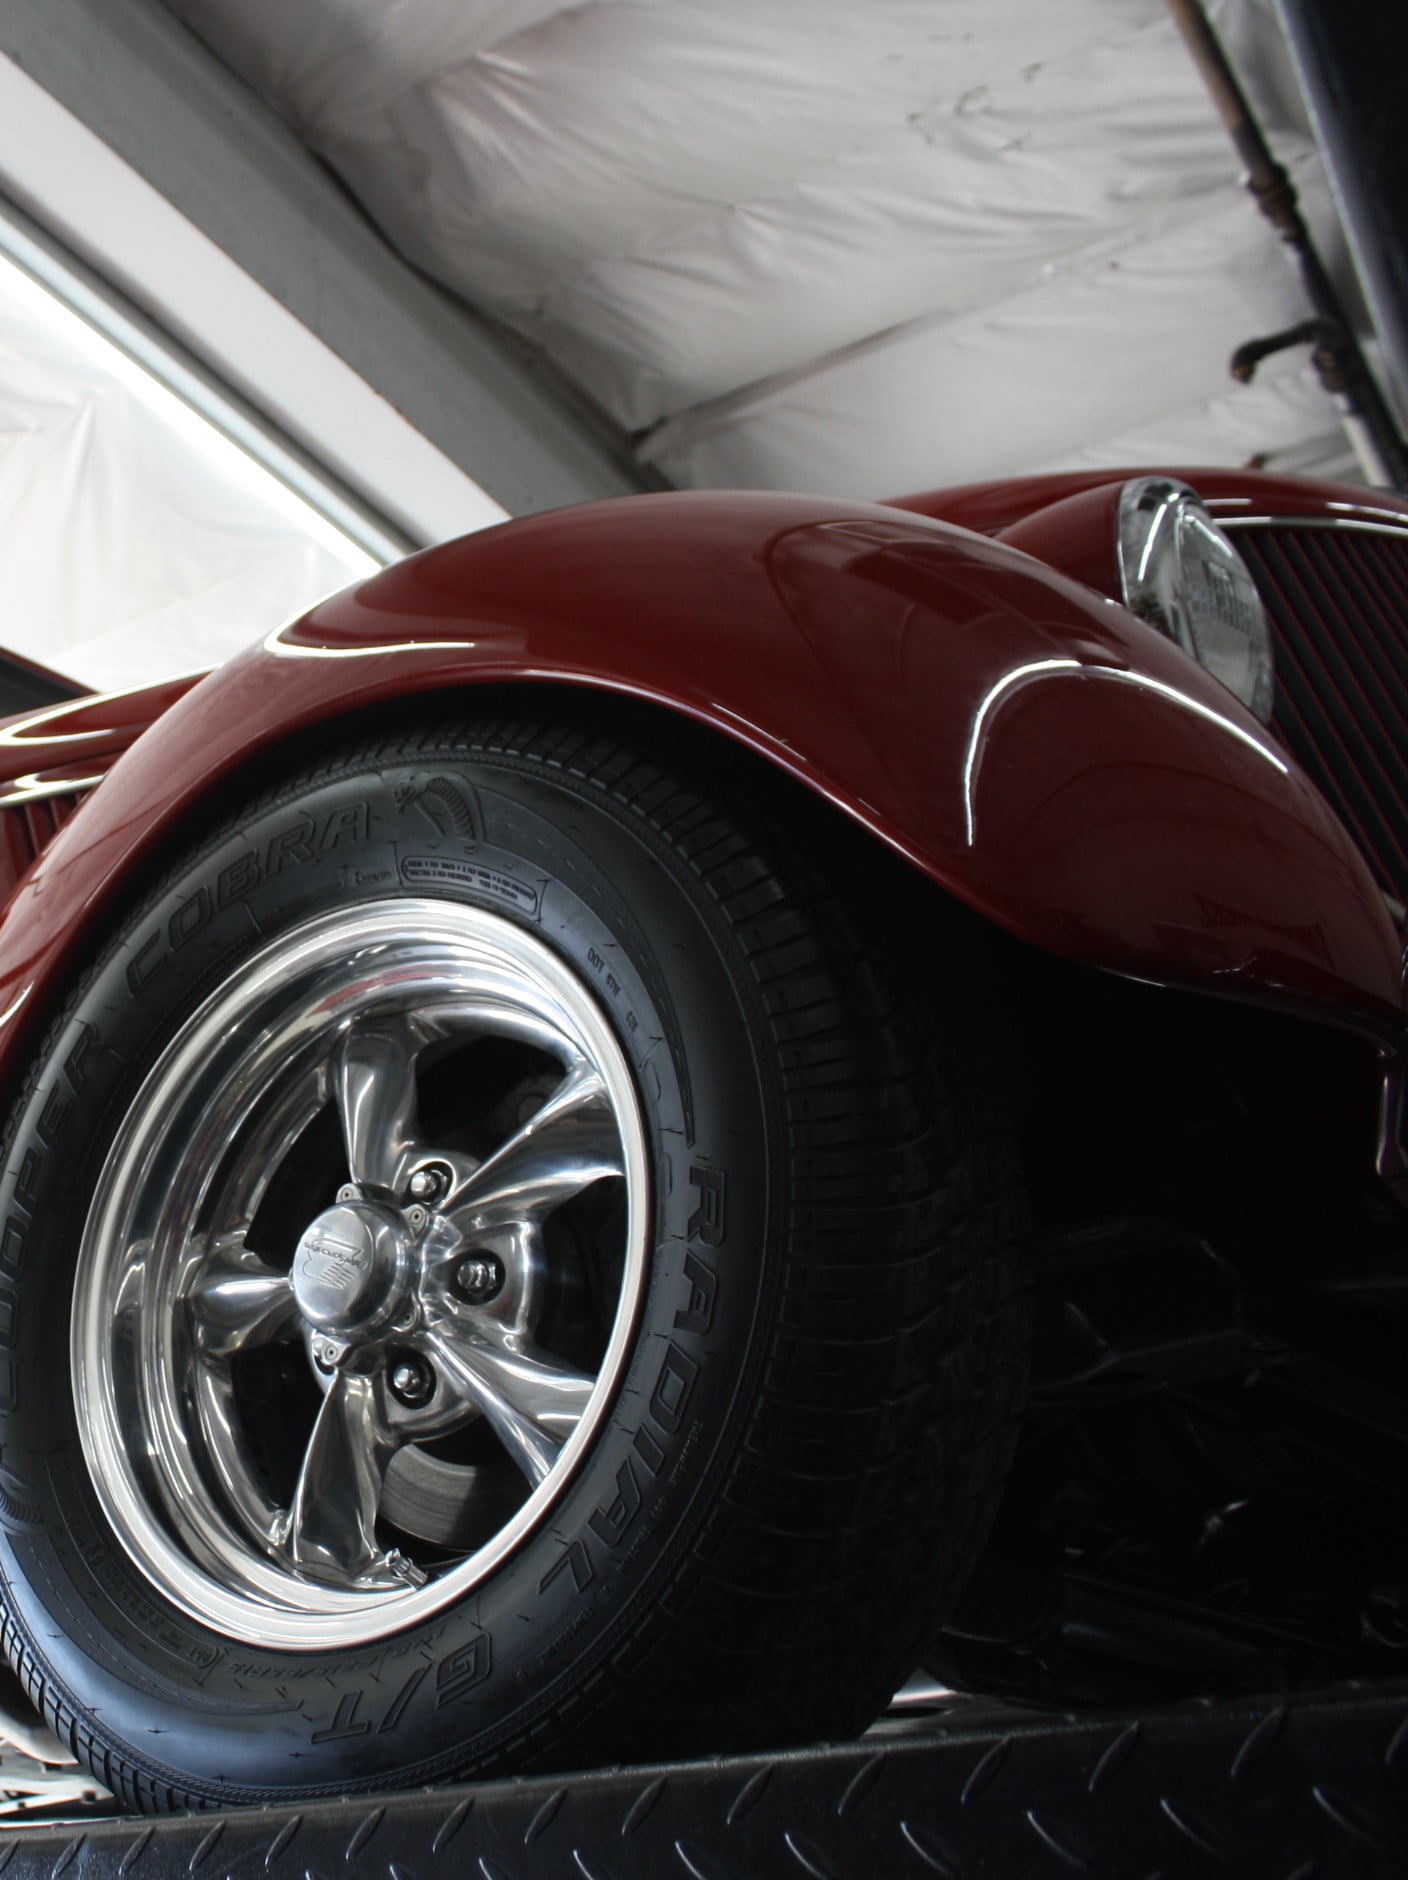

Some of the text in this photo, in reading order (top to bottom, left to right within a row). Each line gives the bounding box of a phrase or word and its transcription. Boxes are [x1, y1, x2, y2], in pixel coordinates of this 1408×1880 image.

[126, 800, 371, 1000] COBRA
[538, 1164, 727, 1595] RADIAL
[308, 1630, 491, 1745] G/T
